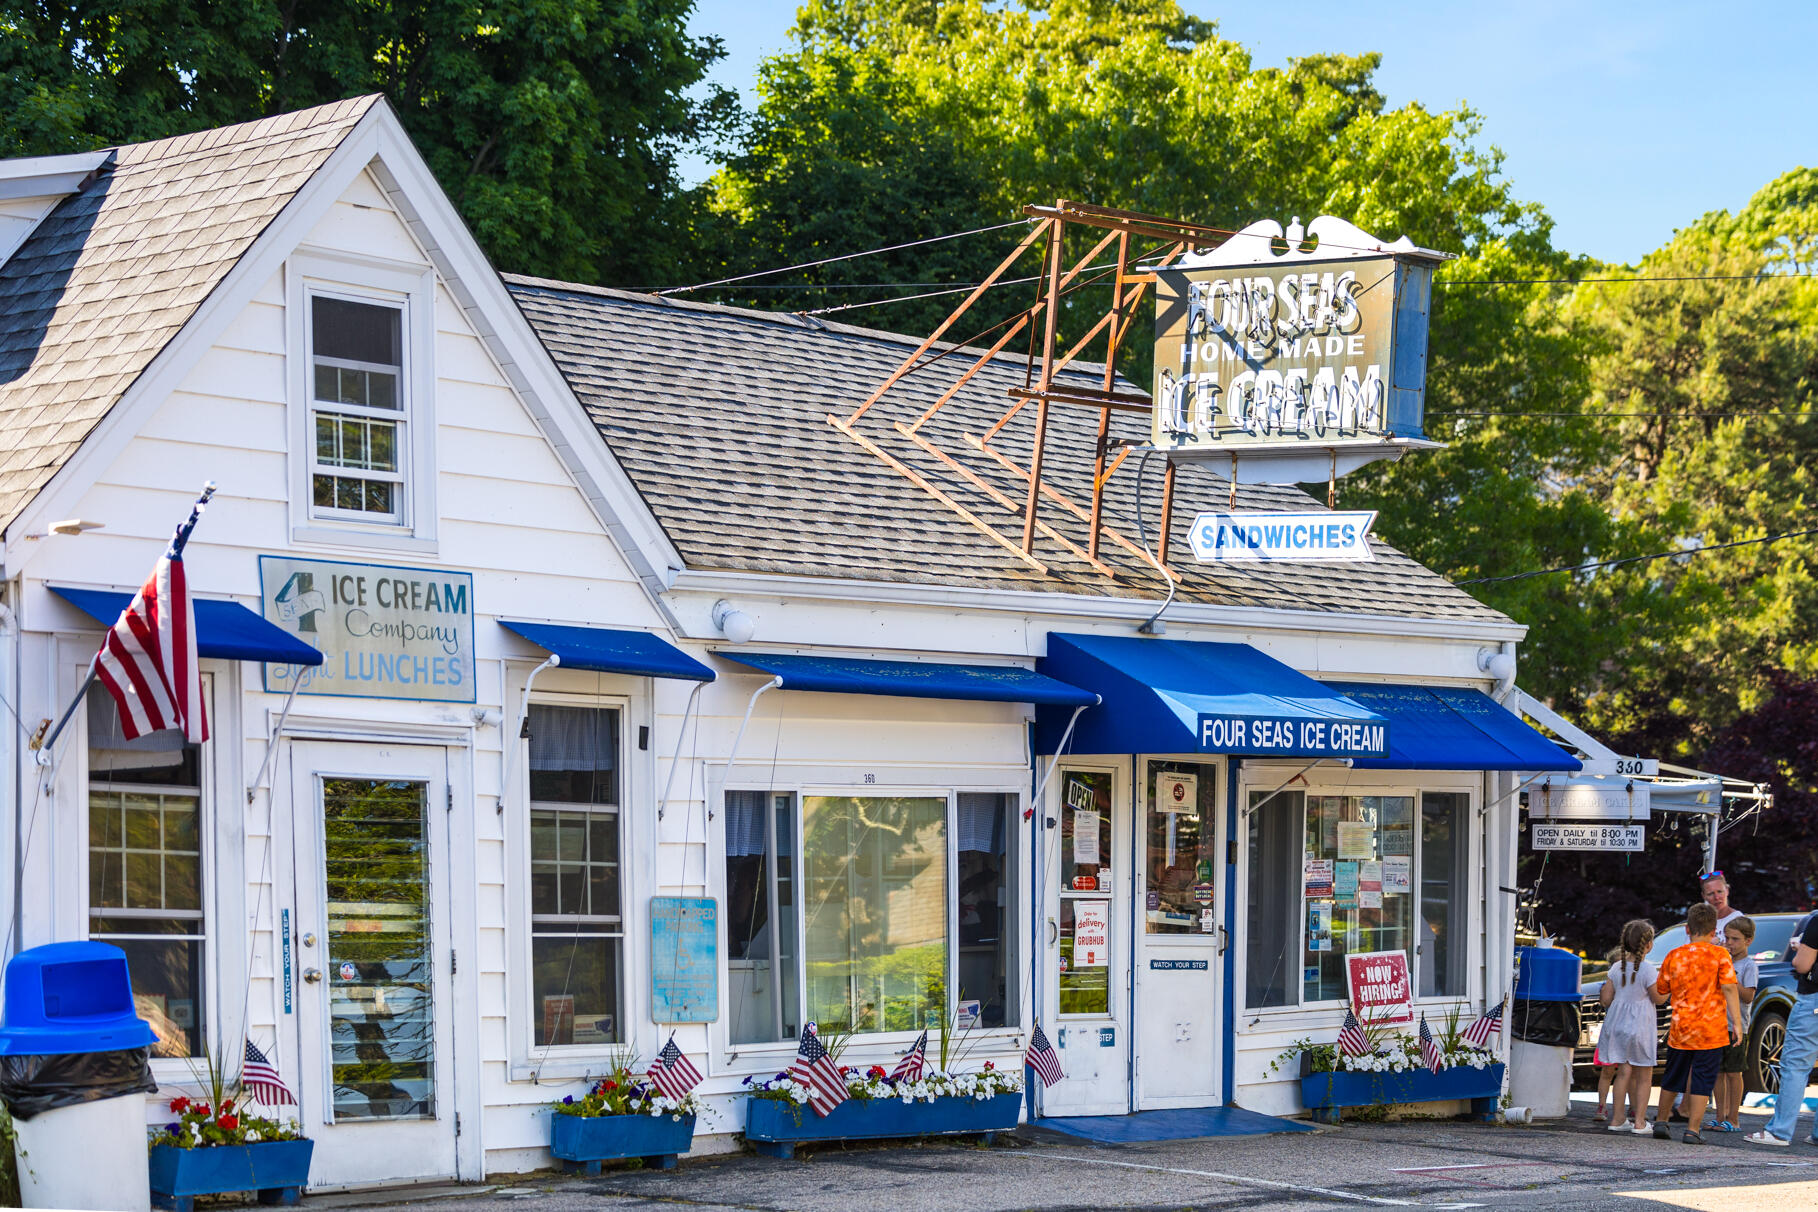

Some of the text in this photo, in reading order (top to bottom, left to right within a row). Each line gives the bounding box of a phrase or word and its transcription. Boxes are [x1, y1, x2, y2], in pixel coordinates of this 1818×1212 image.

[1189, 270, 1357, 335] FOUR SEAS
[1180, 335, 1365, 363] HOME MADE
[1158, 364, 1381, 433] ICE CREAM
[1201, 524, 1356, 549] SANDWICHES
[332, 574, 467, 614] ICE CREAM
[344, 608, 459, 655] Company
[344, 651, 463, 686] LUNCHES
[1202, 719, 1384, 752] FOUR SEAS ICE CREAM
[1616, 761, 1643, 774] 360
[1070, 782, 1093, 811] OPEN
[1537, 829, 1559, 837] OPEN
[1563, 829, 1585, 837] DAILY
[1601, 828, 1621, 838] 8:00
[1625, 830, 1638, 838] PM
[1077, 917, 1105, 930] delivery
[1077, 935, 1105, 946] GRUBHUB
[1365, 965, 1392, 983] NOW
[1099, 1033, 1113, 1042] STEP
